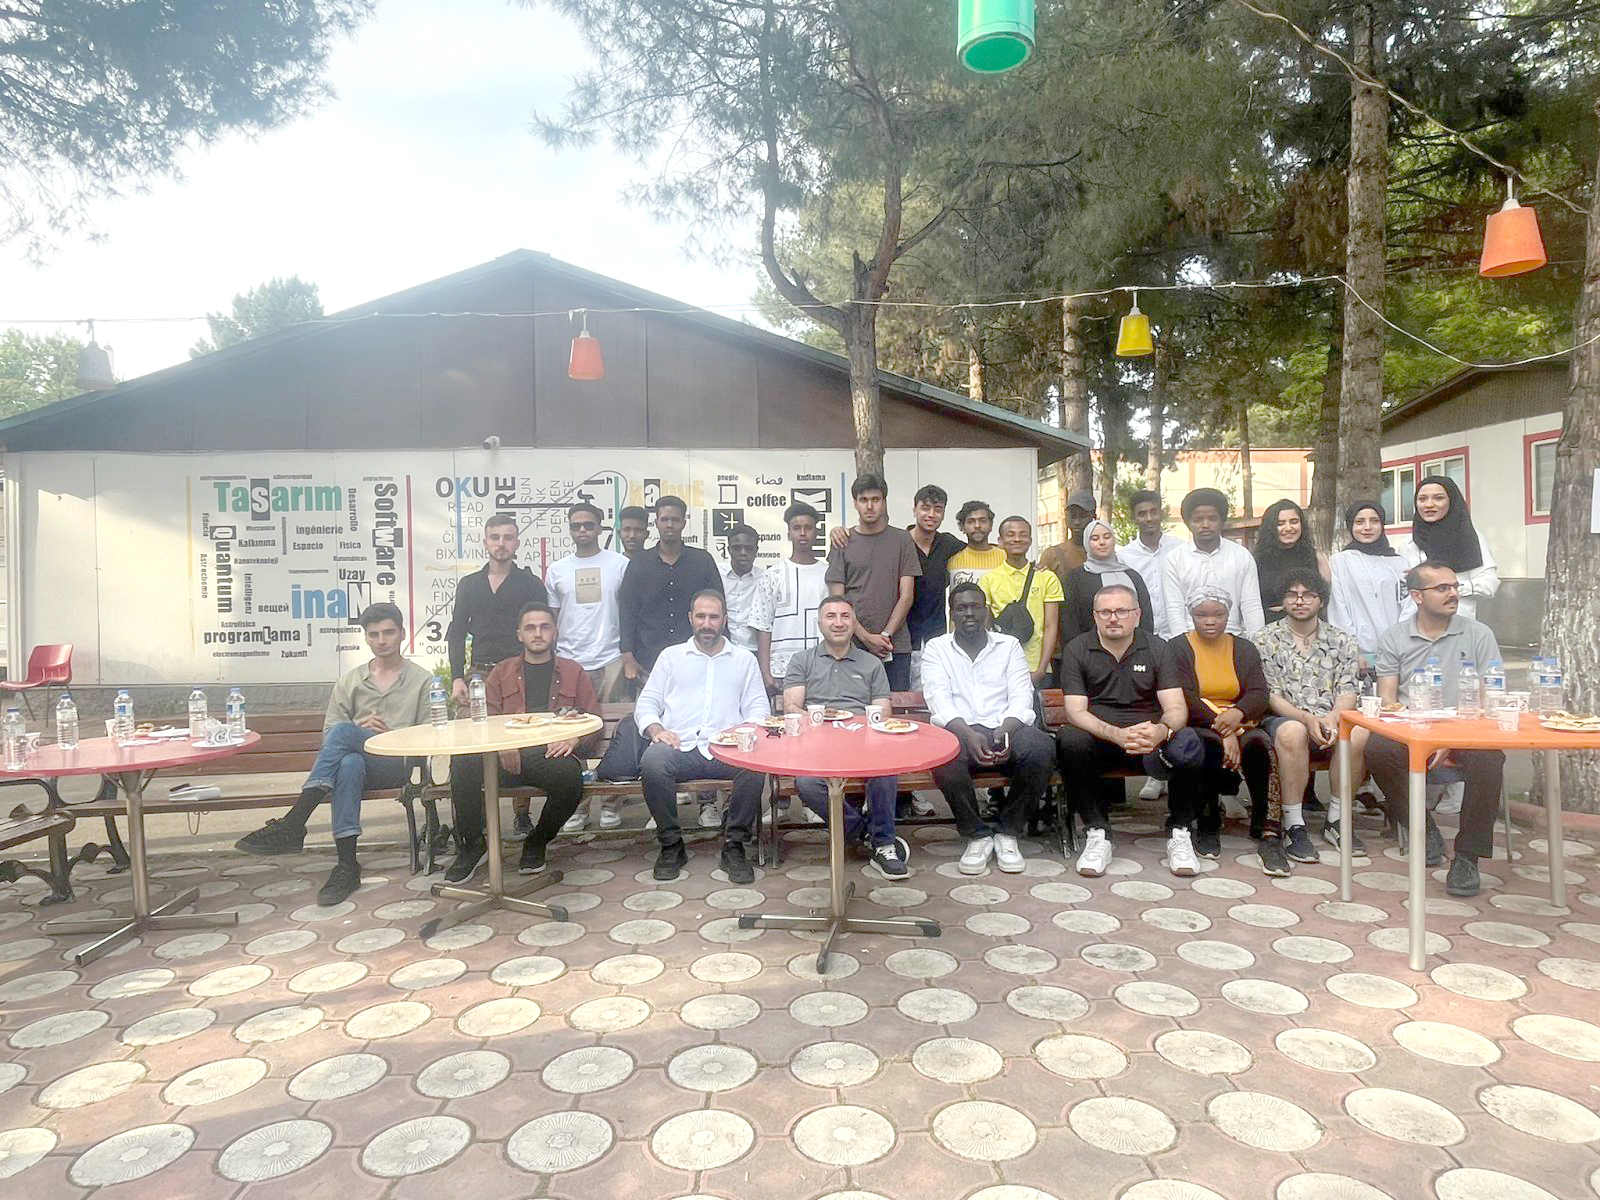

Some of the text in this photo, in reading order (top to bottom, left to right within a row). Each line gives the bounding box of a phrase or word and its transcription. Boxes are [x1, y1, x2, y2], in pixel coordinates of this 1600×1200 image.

[435, 476, 490, 498] OKU
[746, 494, 787, 507] coffee
[447, 501, 484, 513] READ
[550, 480, 562, 534] DENKEN
[449, 516, 484, 528] LEER
[682, 535, 698, 544] unft
[292, 541, 324, 551] Espacio
[338, 568, 366, 581] Uzay
